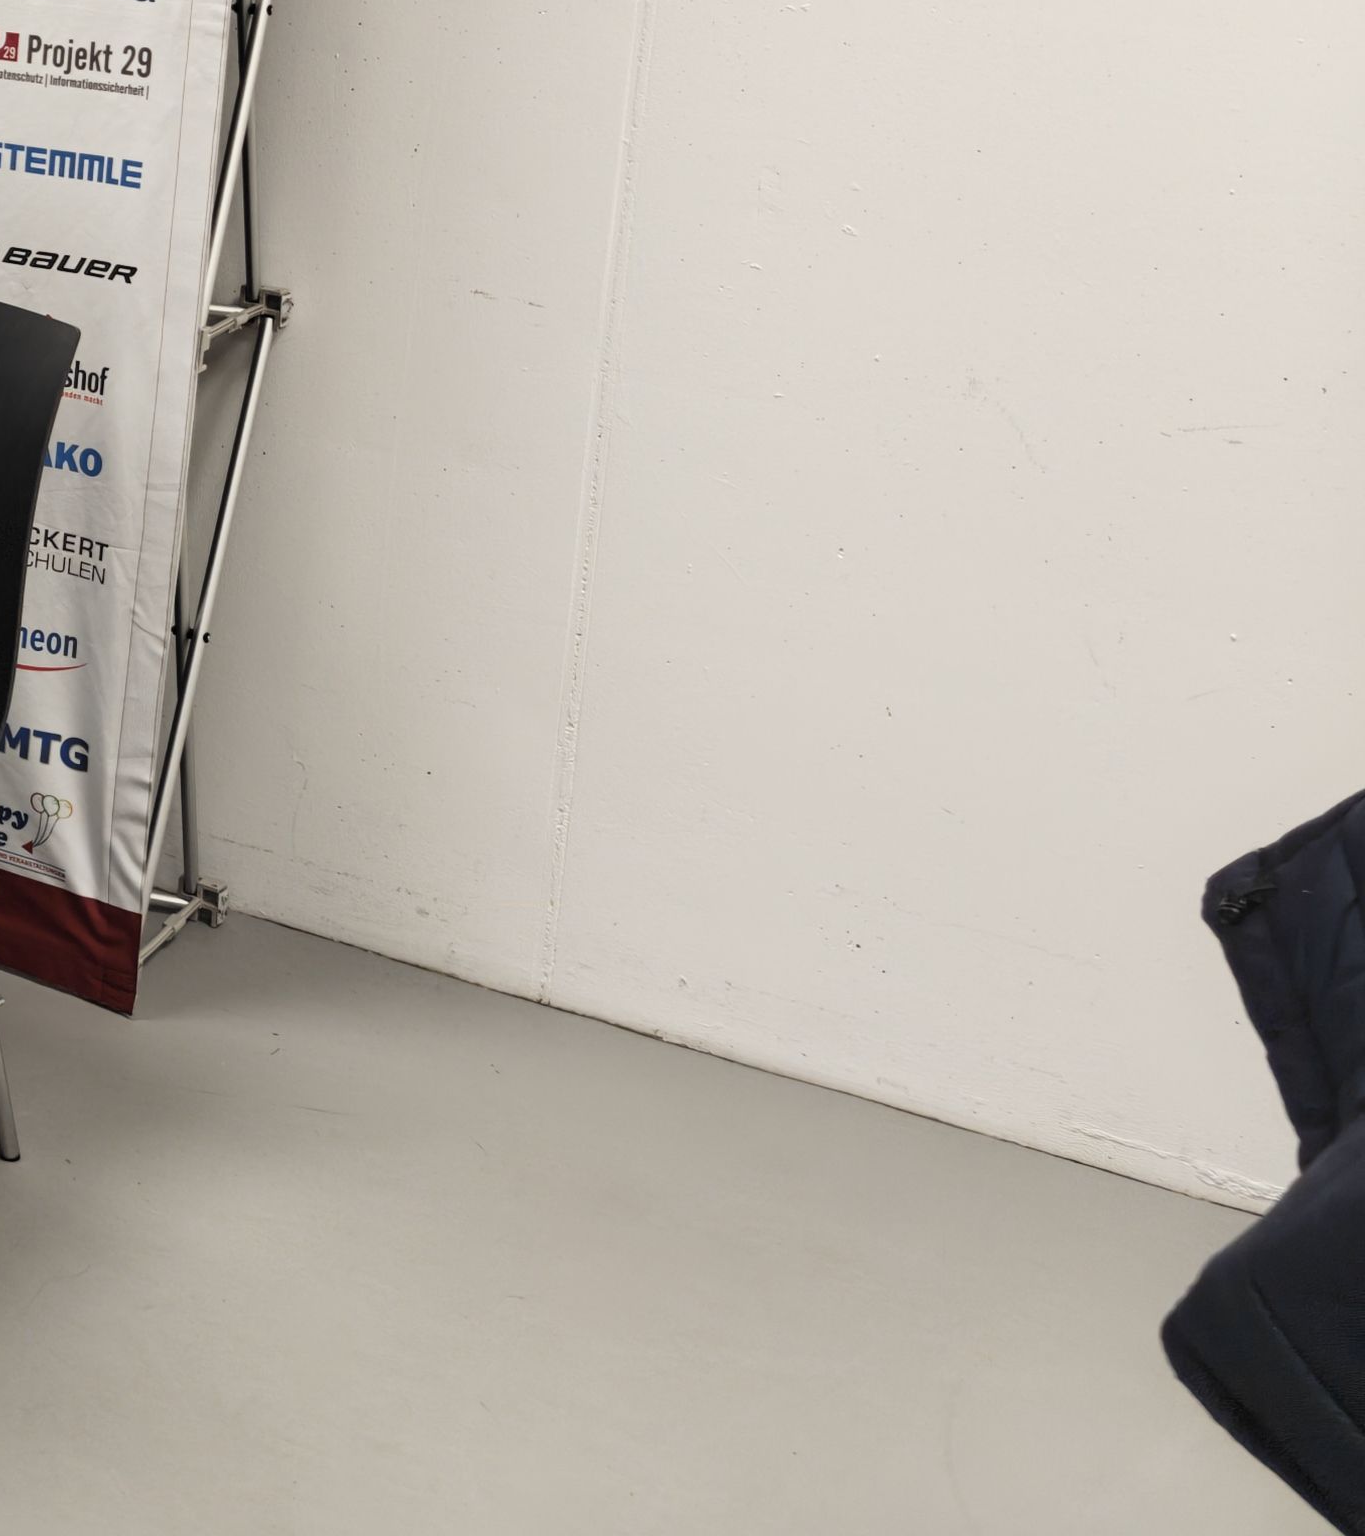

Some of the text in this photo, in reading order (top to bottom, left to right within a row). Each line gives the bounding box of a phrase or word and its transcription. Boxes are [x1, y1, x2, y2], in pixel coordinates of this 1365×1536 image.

[27, 34, 152, 78] Projekt 29
[49, 74, 145, 98] Informationssicherheit
[31, 527, 109, 561] CKERT
[26, 551, 106, 585] CHULEN
